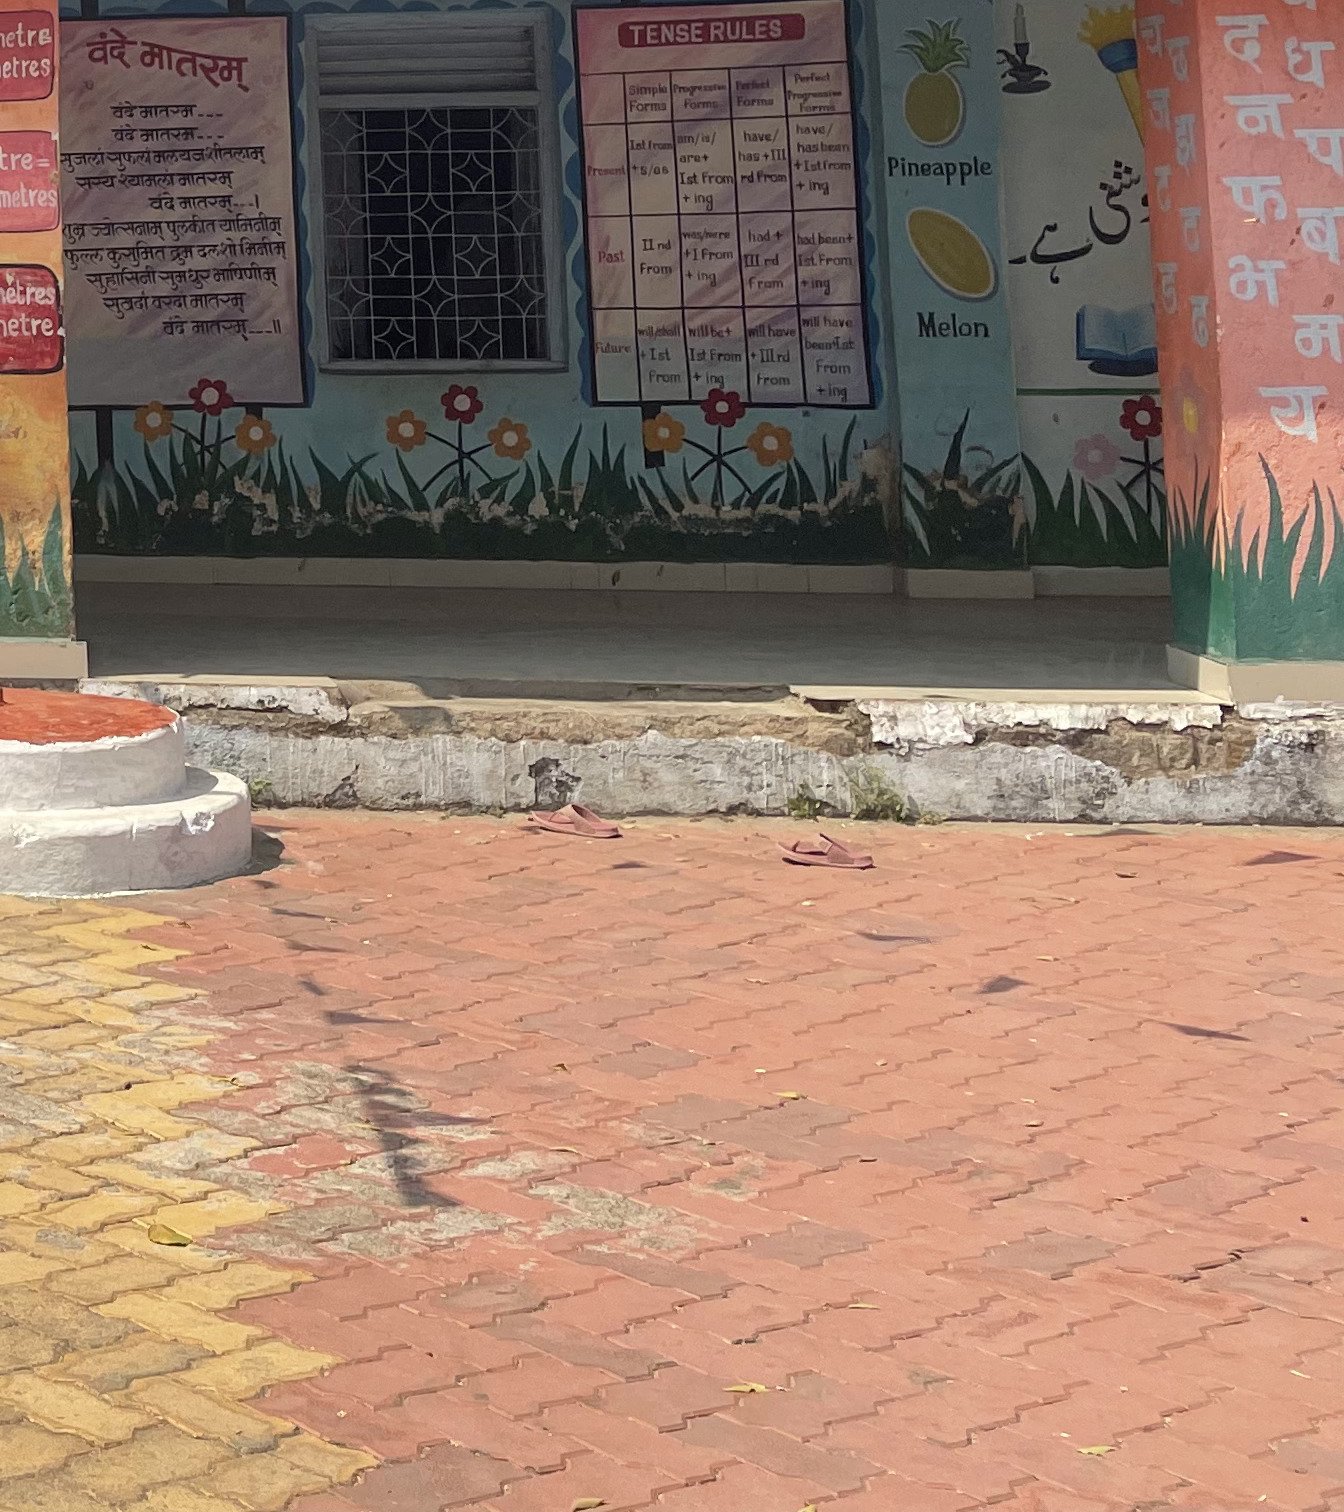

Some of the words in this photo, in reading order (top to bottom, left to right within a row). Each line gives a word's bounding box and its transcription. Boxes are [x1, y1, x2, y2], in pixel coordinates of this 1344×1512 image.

[629, 22, 704, 45] TENSE
[709, 19, 782, 41] RULES
[1215, 14, 1269, 74] द
[86, 28, 138, 68] वंदे
[140, 41, 250, 93] मातरम्
[1284, 36, 1336, 89] ध
[794, 73, 830, 84] Perfect
[630, 100, 667, 112] Forms
[1224, 93, 1294, 140] न
[587, 166, 625, 177] Present
[888, 156, 992, 185] Pineapple
[1221, 175, 1287, 225] फ
[598, 249, 625, 263] Past
[1228, 254, 1288, 307] भ
[917, 312, 989, 337] Melon
[596, 342, 631, 354] Future
[1259, 385, 1329, 443] य
